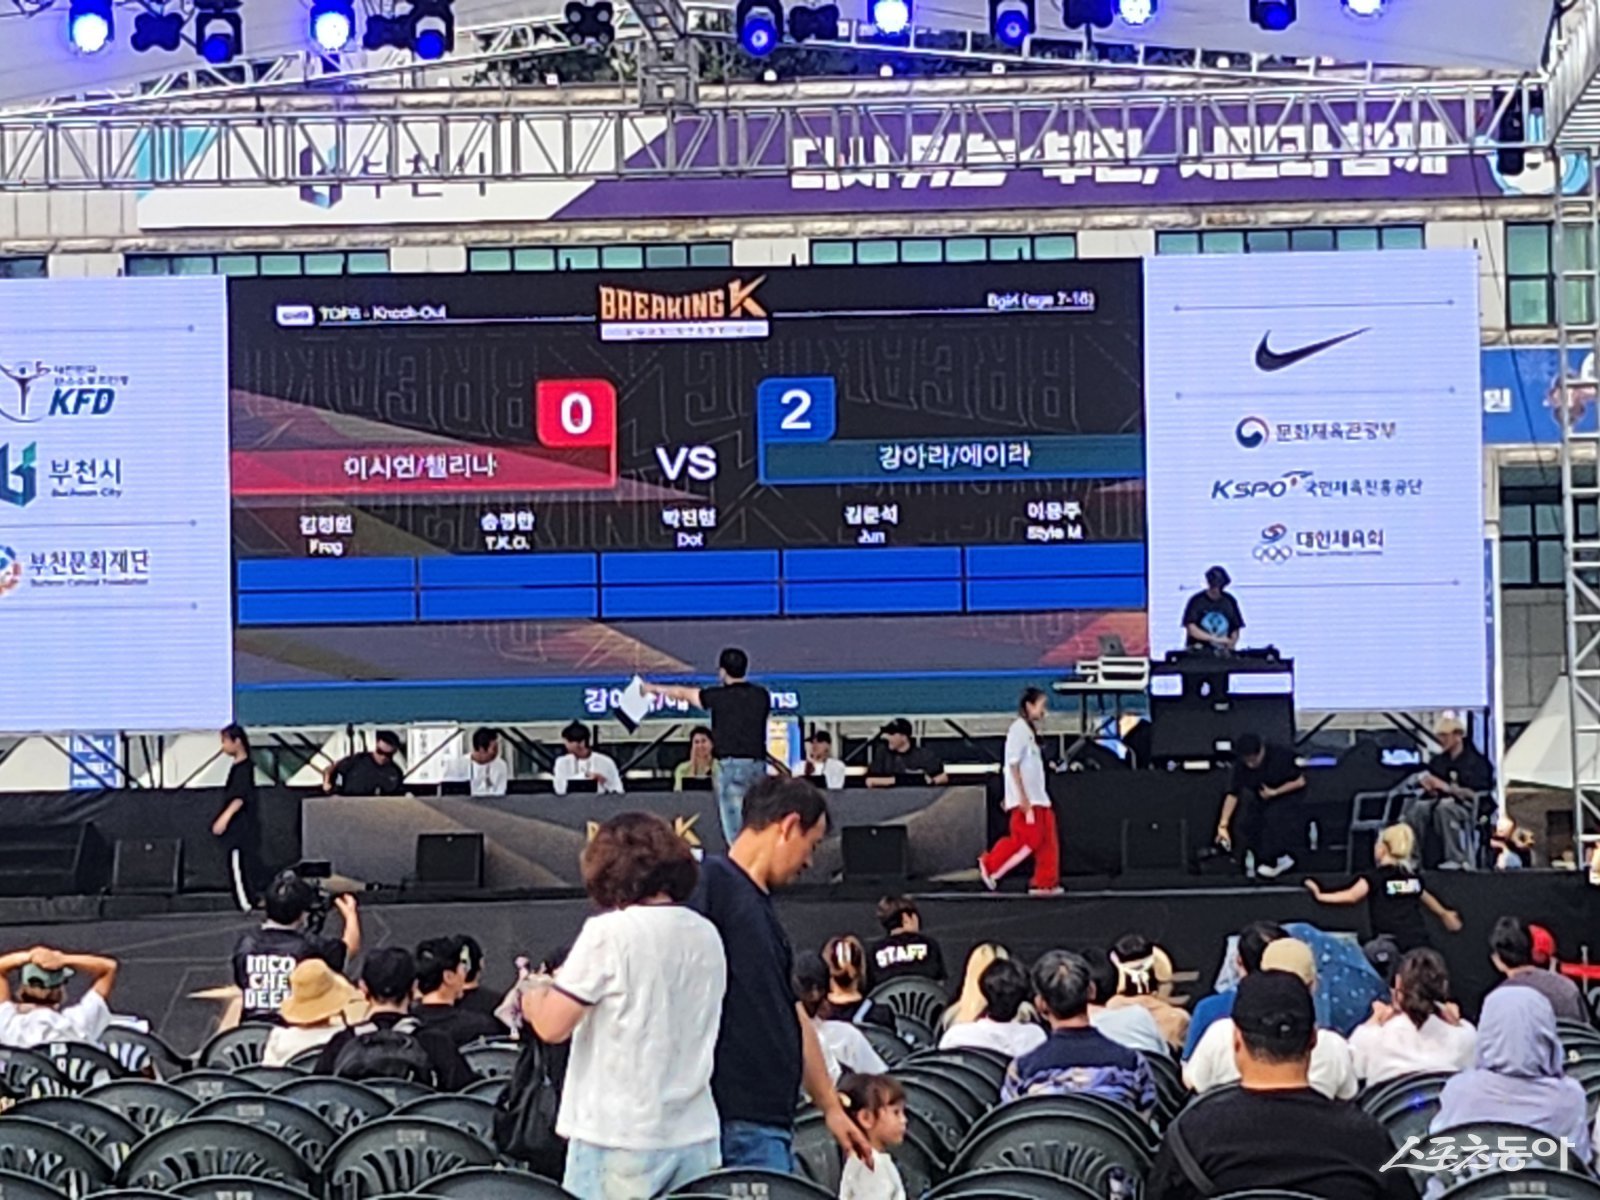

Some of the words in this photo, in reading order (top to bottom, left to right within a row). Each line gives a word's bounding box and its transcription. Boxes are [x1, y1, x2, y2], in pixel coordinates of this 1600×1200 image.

[599, 285, 725, 320] BREAKING
[728, 273, 768, 318] K
[48, 388, 116, 416] KFD
[561, 392, 592, 435] 0
[781, 390, 812, 430] 2
[49, 458, 121, 485] 부천시
[656, 446, 717, 480] VS
[1212, 480, 1287, 499] KSPO
[30, 550, 149, 575] 부천문화재단
[876, 943, 928, 968] STAFF
